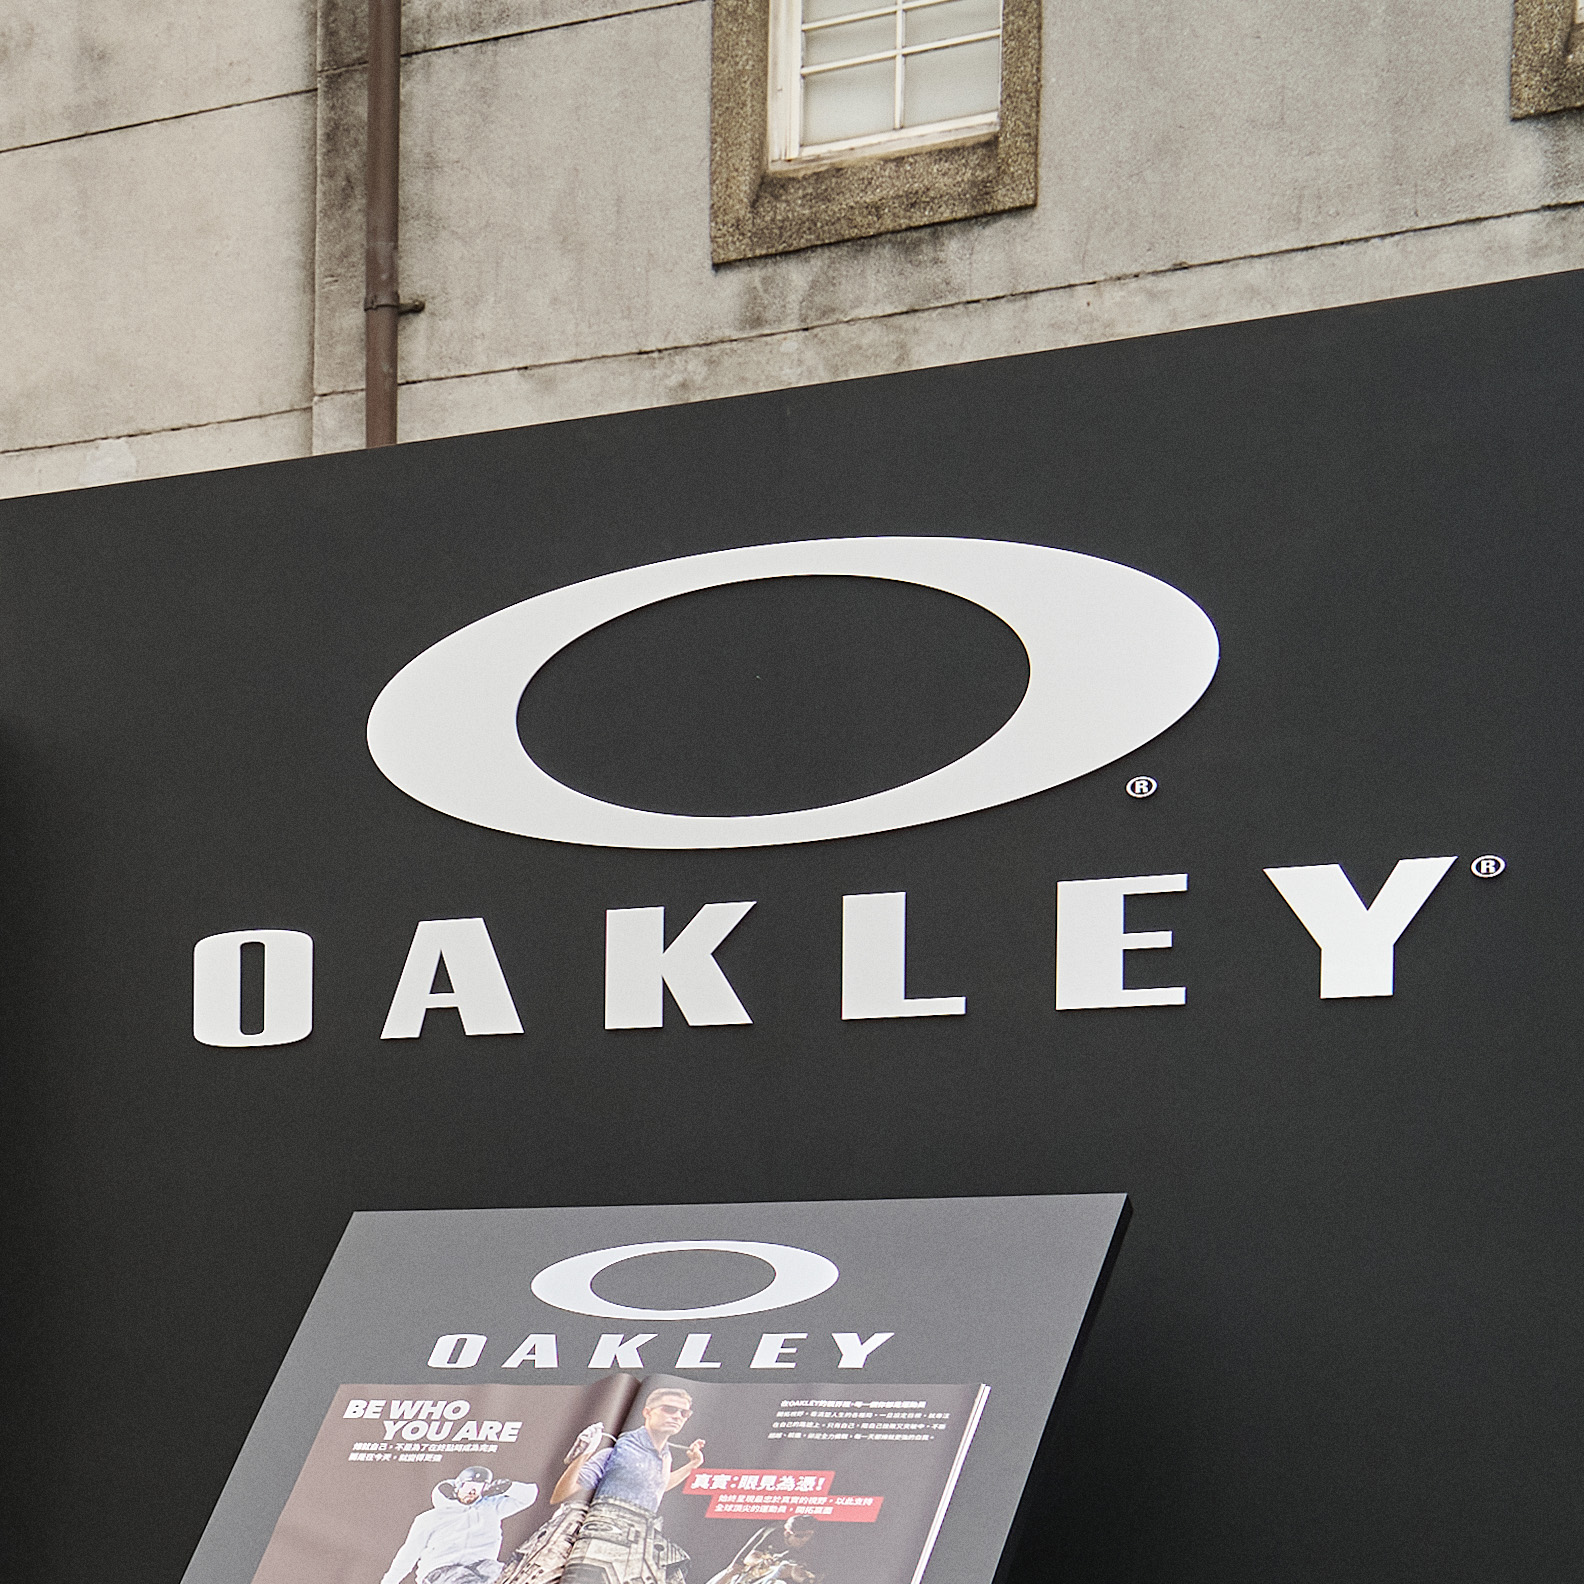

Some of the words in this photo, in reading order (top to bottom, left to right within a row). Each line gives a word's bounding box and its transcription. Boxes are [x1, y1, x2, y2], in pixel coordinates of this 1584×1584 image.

[193, 856, 1459, 1049] OAKLEY
[427, 1332, 895, 1370] OAKLEY
[343, 1400, 387, 1420] BE
[388, 1400, 472, 1421] WHO
[383, 1420, 458, 1443] YOU
[452, 1421, 524, 1443] ARE
